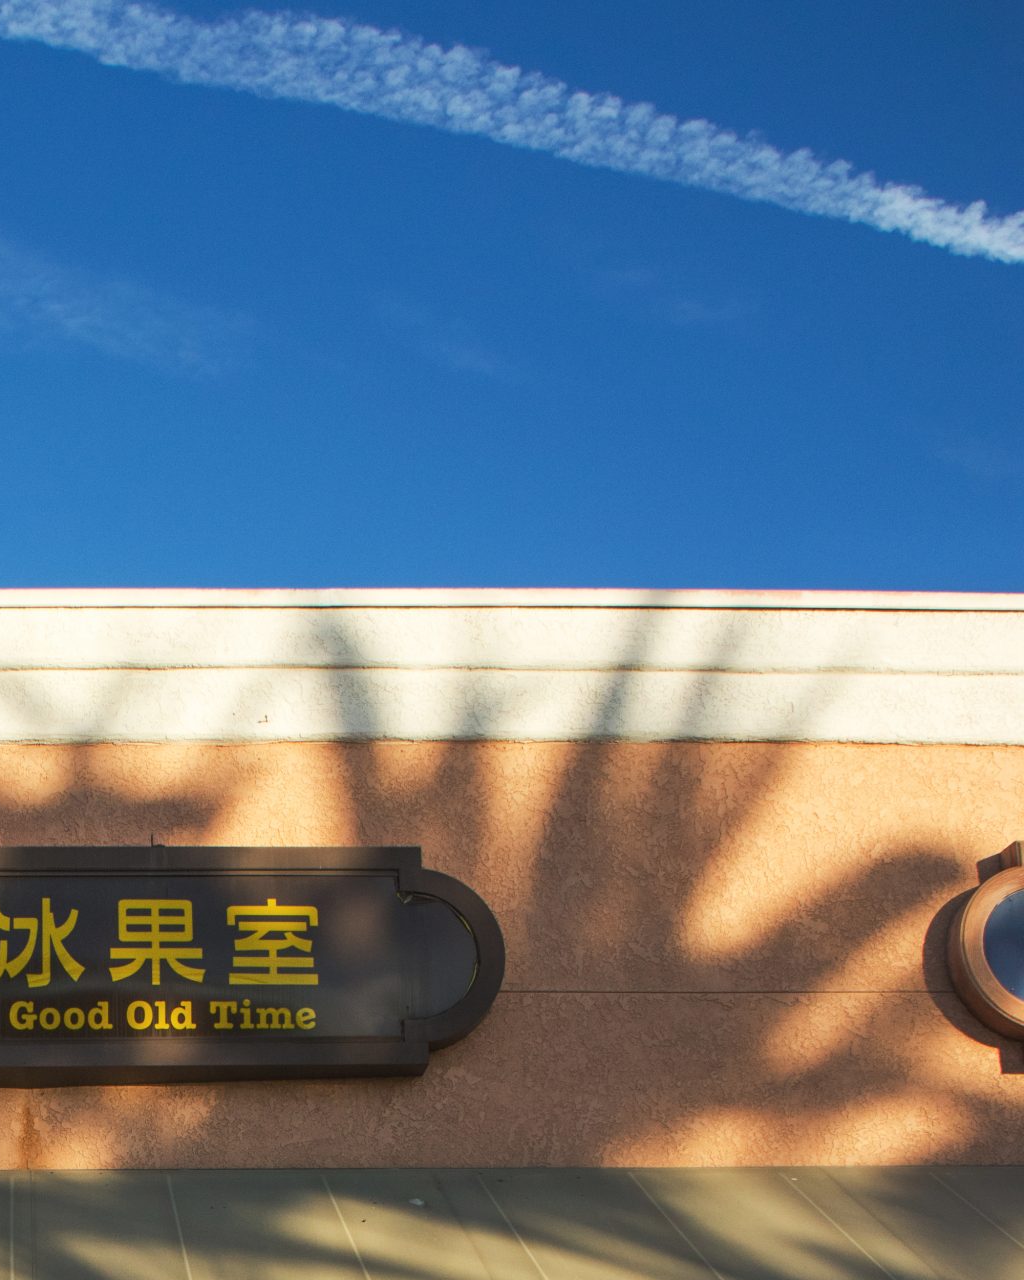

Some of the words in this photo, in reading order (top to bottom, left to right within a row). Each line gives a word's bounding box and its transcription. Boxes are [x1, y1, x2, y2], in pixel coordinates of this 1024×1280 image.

[9, 1000, 113, 1031] Good
[126, 1000, 197, 1031] Old
[210, 999, 317, 1031] Time
